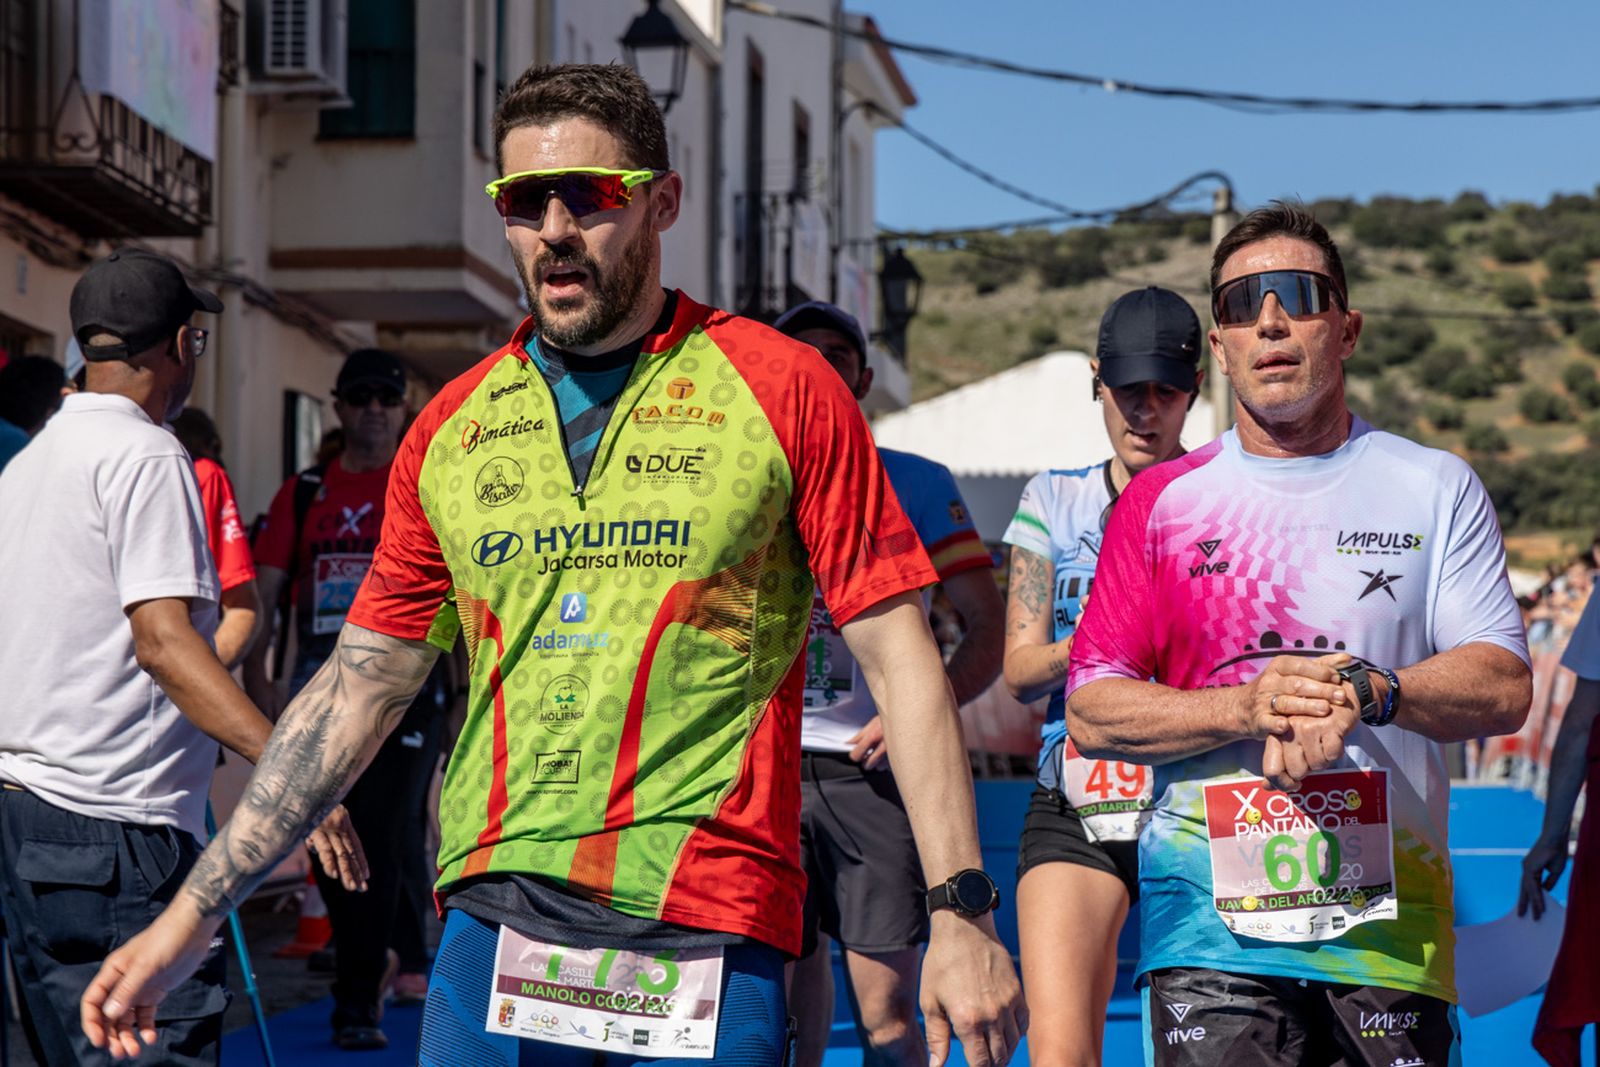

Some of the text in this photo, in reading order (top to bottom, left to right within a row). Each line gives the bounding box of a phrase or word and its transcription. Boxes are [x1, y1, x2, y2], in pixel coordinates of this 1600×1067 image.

[632, 405, 726, 425] TACOM
[646, 454, 704, 474] DUE
[534, 520, 691, 554] HYUNDAI
[1337, 530, 1425, 551] IMPULSE
[537, 550, 688, 576] Jacarsa Motor
[1189, 560, 1230, 578] vive
[1085, 760, 1145, 799] 49
[1234, 813, 1341, 841] PANTANO
[1264, 831, 1341, 891] 60
[1218, 898, 1265, 911] JAVR
[1269, 896, 1294, 909] DEL
[521, 982, 591, 1005] MANOLO
[1165, 1025, 1206, 1045] vive
